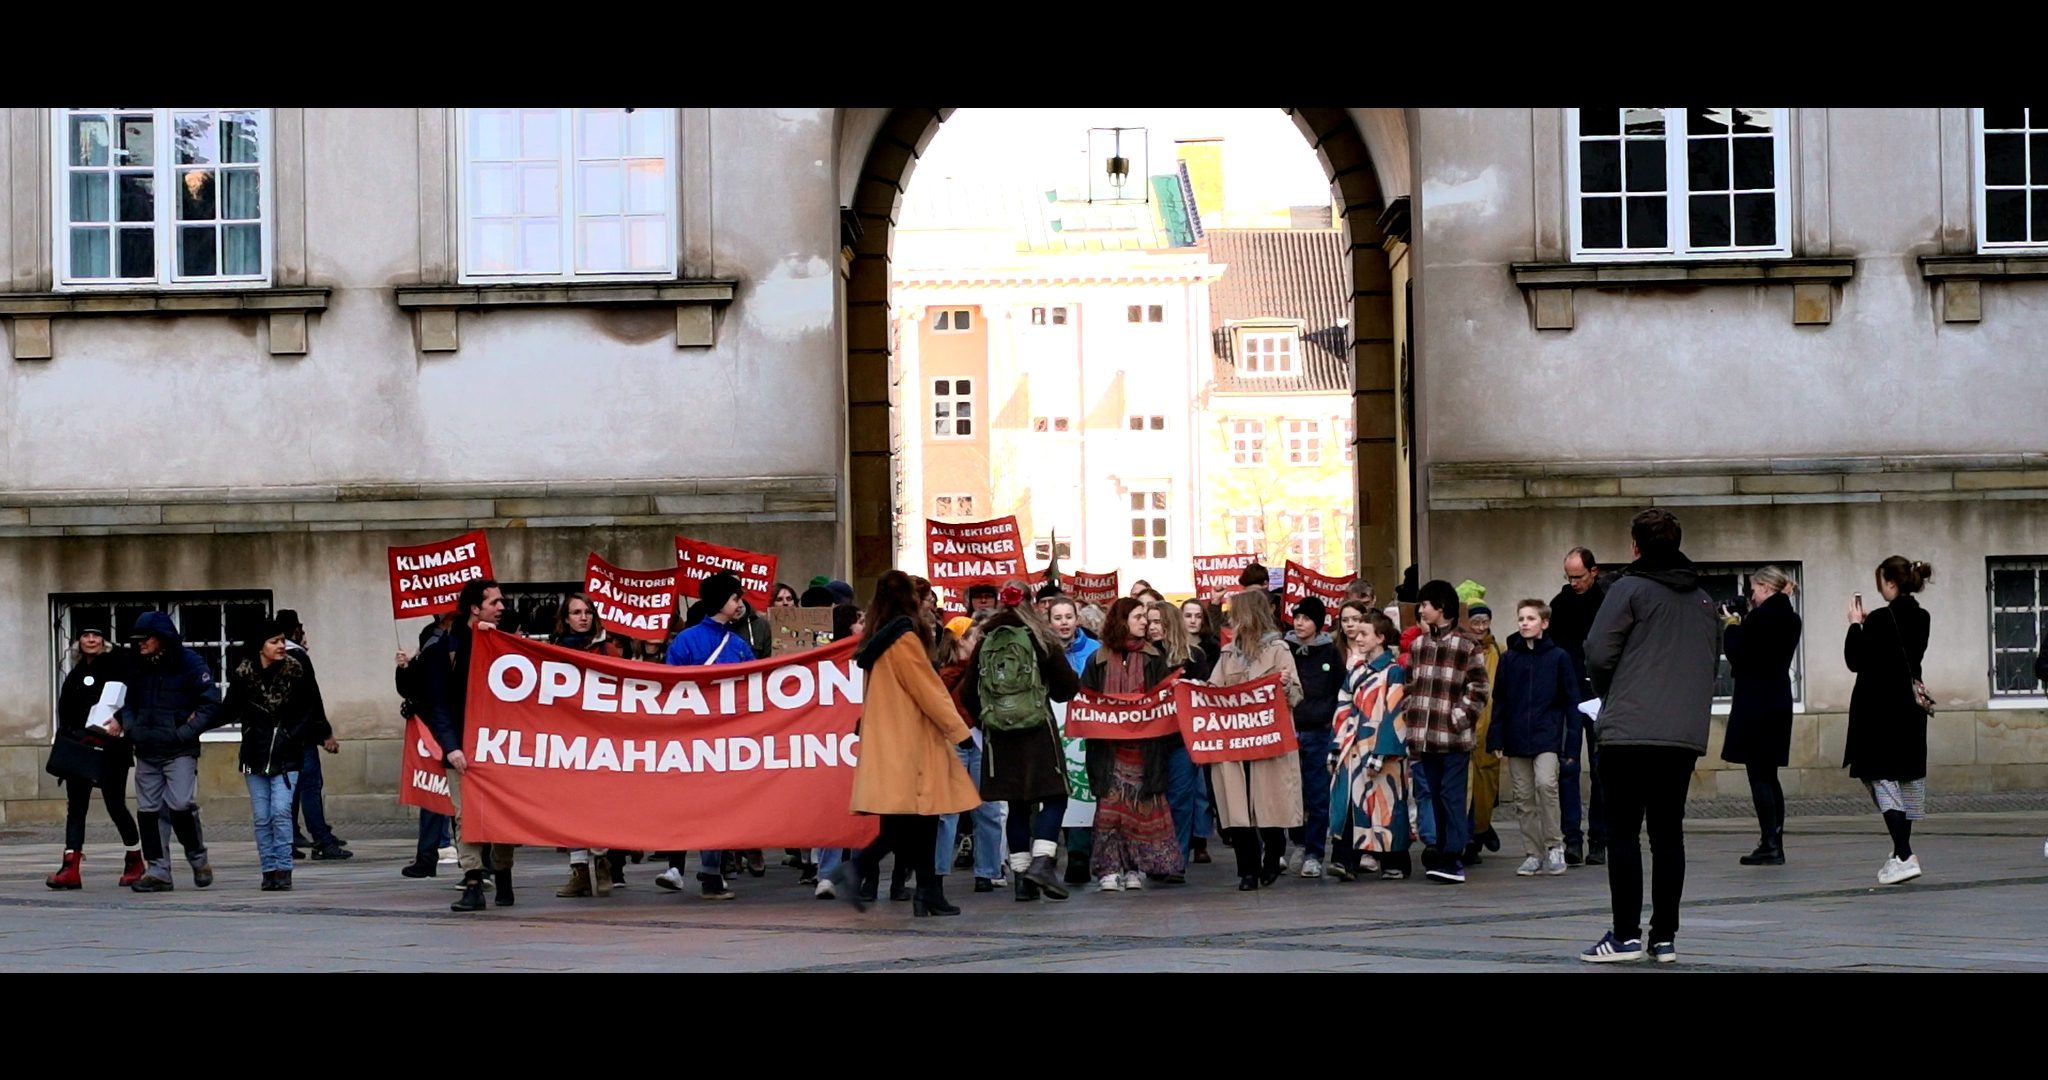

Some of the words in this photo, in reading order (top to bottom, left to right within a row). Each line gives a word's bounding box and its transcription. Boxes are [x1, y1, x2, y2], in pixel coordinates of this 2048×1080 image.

[396, 542, 476, 571] KLIMAET
[933, 539, 1014, 554] PÅVIRKER
[697, 554, 745, 572] POLITIK
[751, 564, 768, 576] ER
[933, 559, 1017, 578] KLIMAET
[400, 565, 483, 592] PÅVIRKER
[401, 597, 428, 609] ALLE
[433, 592, 461, 605] SEKT
[589, 578, 671, 608] PÅVIRKER
[488, 654, 864, 715] OPERATION
[1073, 692, 1090, 704] AL
[1191, 684, 1276, 708] KLIMAET
[1071, 701, 1178, 724] KLIMAPOLITIK
[1192, 739, 1224, 751] ALLE
[1229, 732, 1282, 749] SEKTORER
